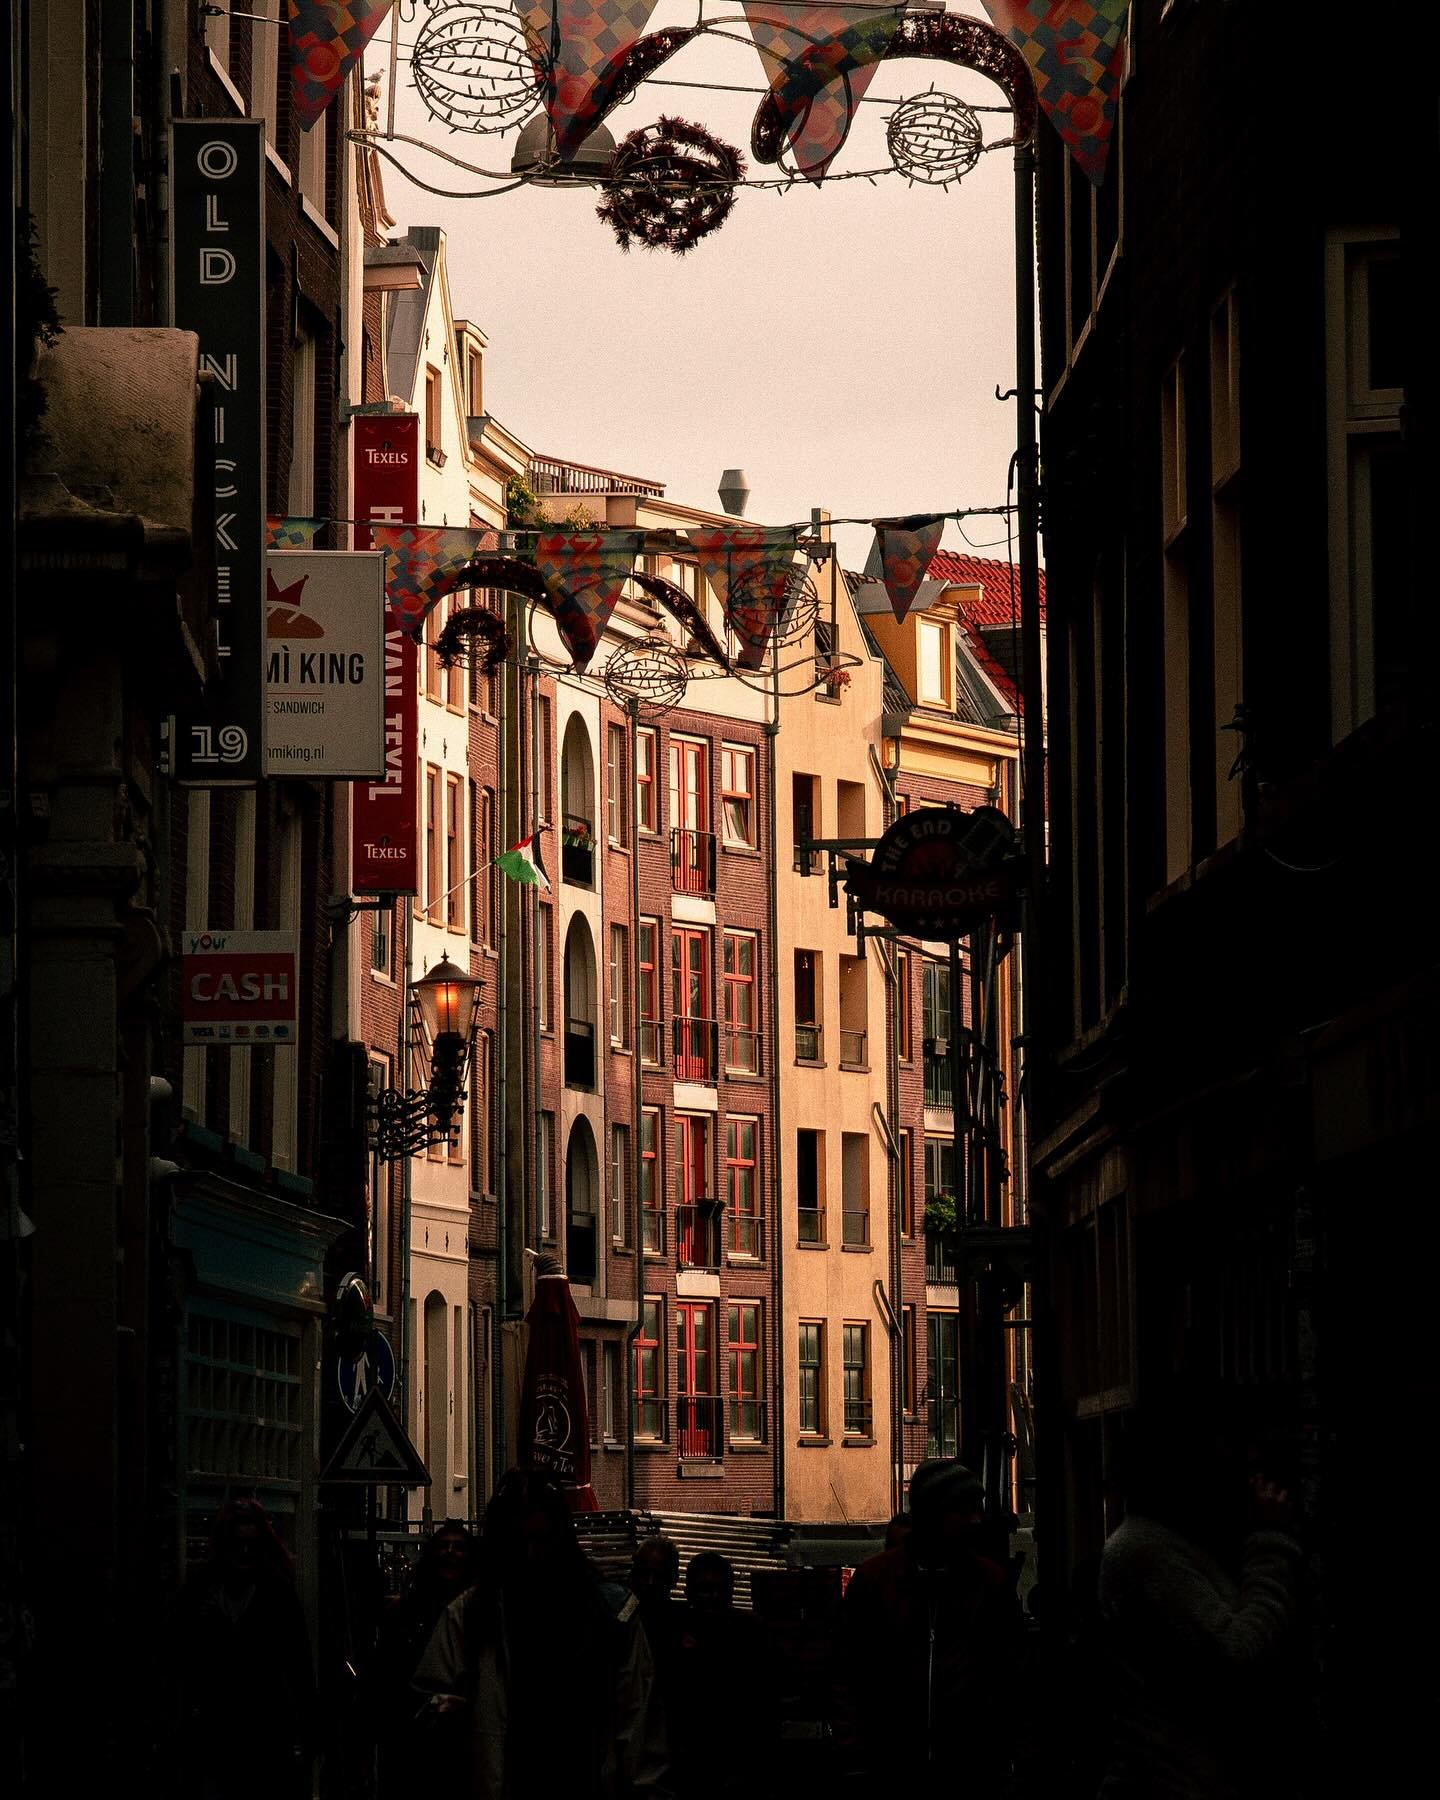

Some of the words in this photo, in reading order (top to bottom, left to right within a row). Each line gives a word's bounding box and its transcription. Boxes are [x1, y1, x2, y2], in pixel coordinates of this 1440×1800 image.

[197, 140, 238, 285] OLD
[300, 652, 364, 685] KING
[273, 701, 325, 714] SANDWICH
[191, 725, 249, 763] 19
[874, 879, 1001, 909] KARAOKE
[190, 972, 289, 1002] CASH
